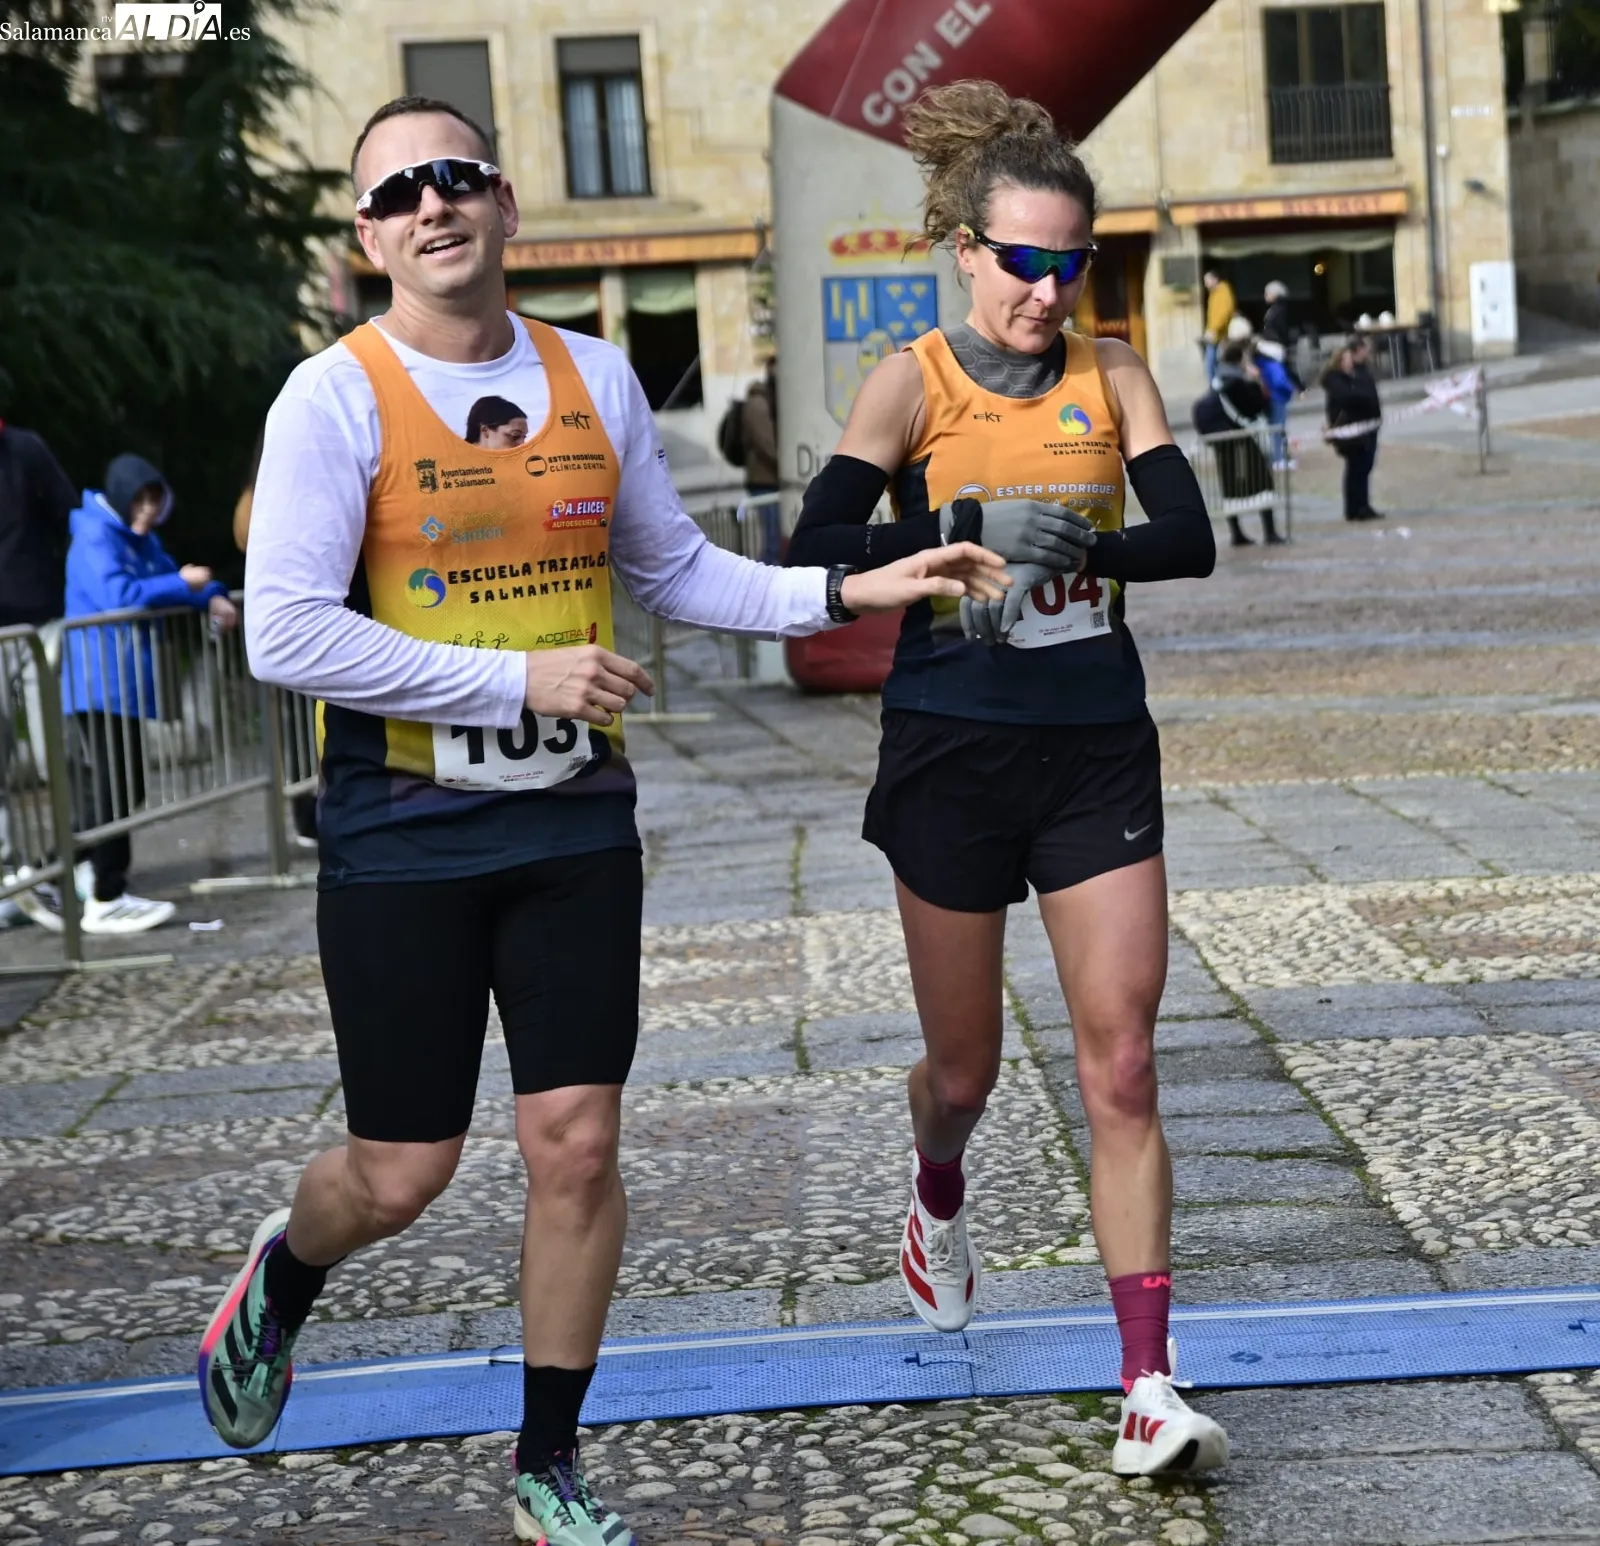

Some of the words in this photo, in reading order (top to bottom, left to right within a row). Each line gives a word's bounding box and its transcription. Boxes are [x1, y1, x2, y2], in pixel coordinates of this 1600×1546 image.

[861, 40, 943, 126] CON
[934, 0, 992, 48] EL
[561, 410, 590, 430] EKT
[440, 467, 493, 479] Ayuntamiento
[797, 442, 831, 478] Di
[443, 481, 453, 489] de
[455, 477, 496, 488] Salamanca
[996, 486, 1043, 497] ESTER
[1048, 482, 1116, 495] RODRÍGUEZ
[552, 519, 597, 529] AUTOESCUELA
[447, 563, 533, 585] ESCUELA
[537, 551, 609, 574] TRIATLÓ
[470, 577, 593, 604] SALMANTINA
[1017, 572, 1102, 619] 04
[451, 707, 578, 765] 103
